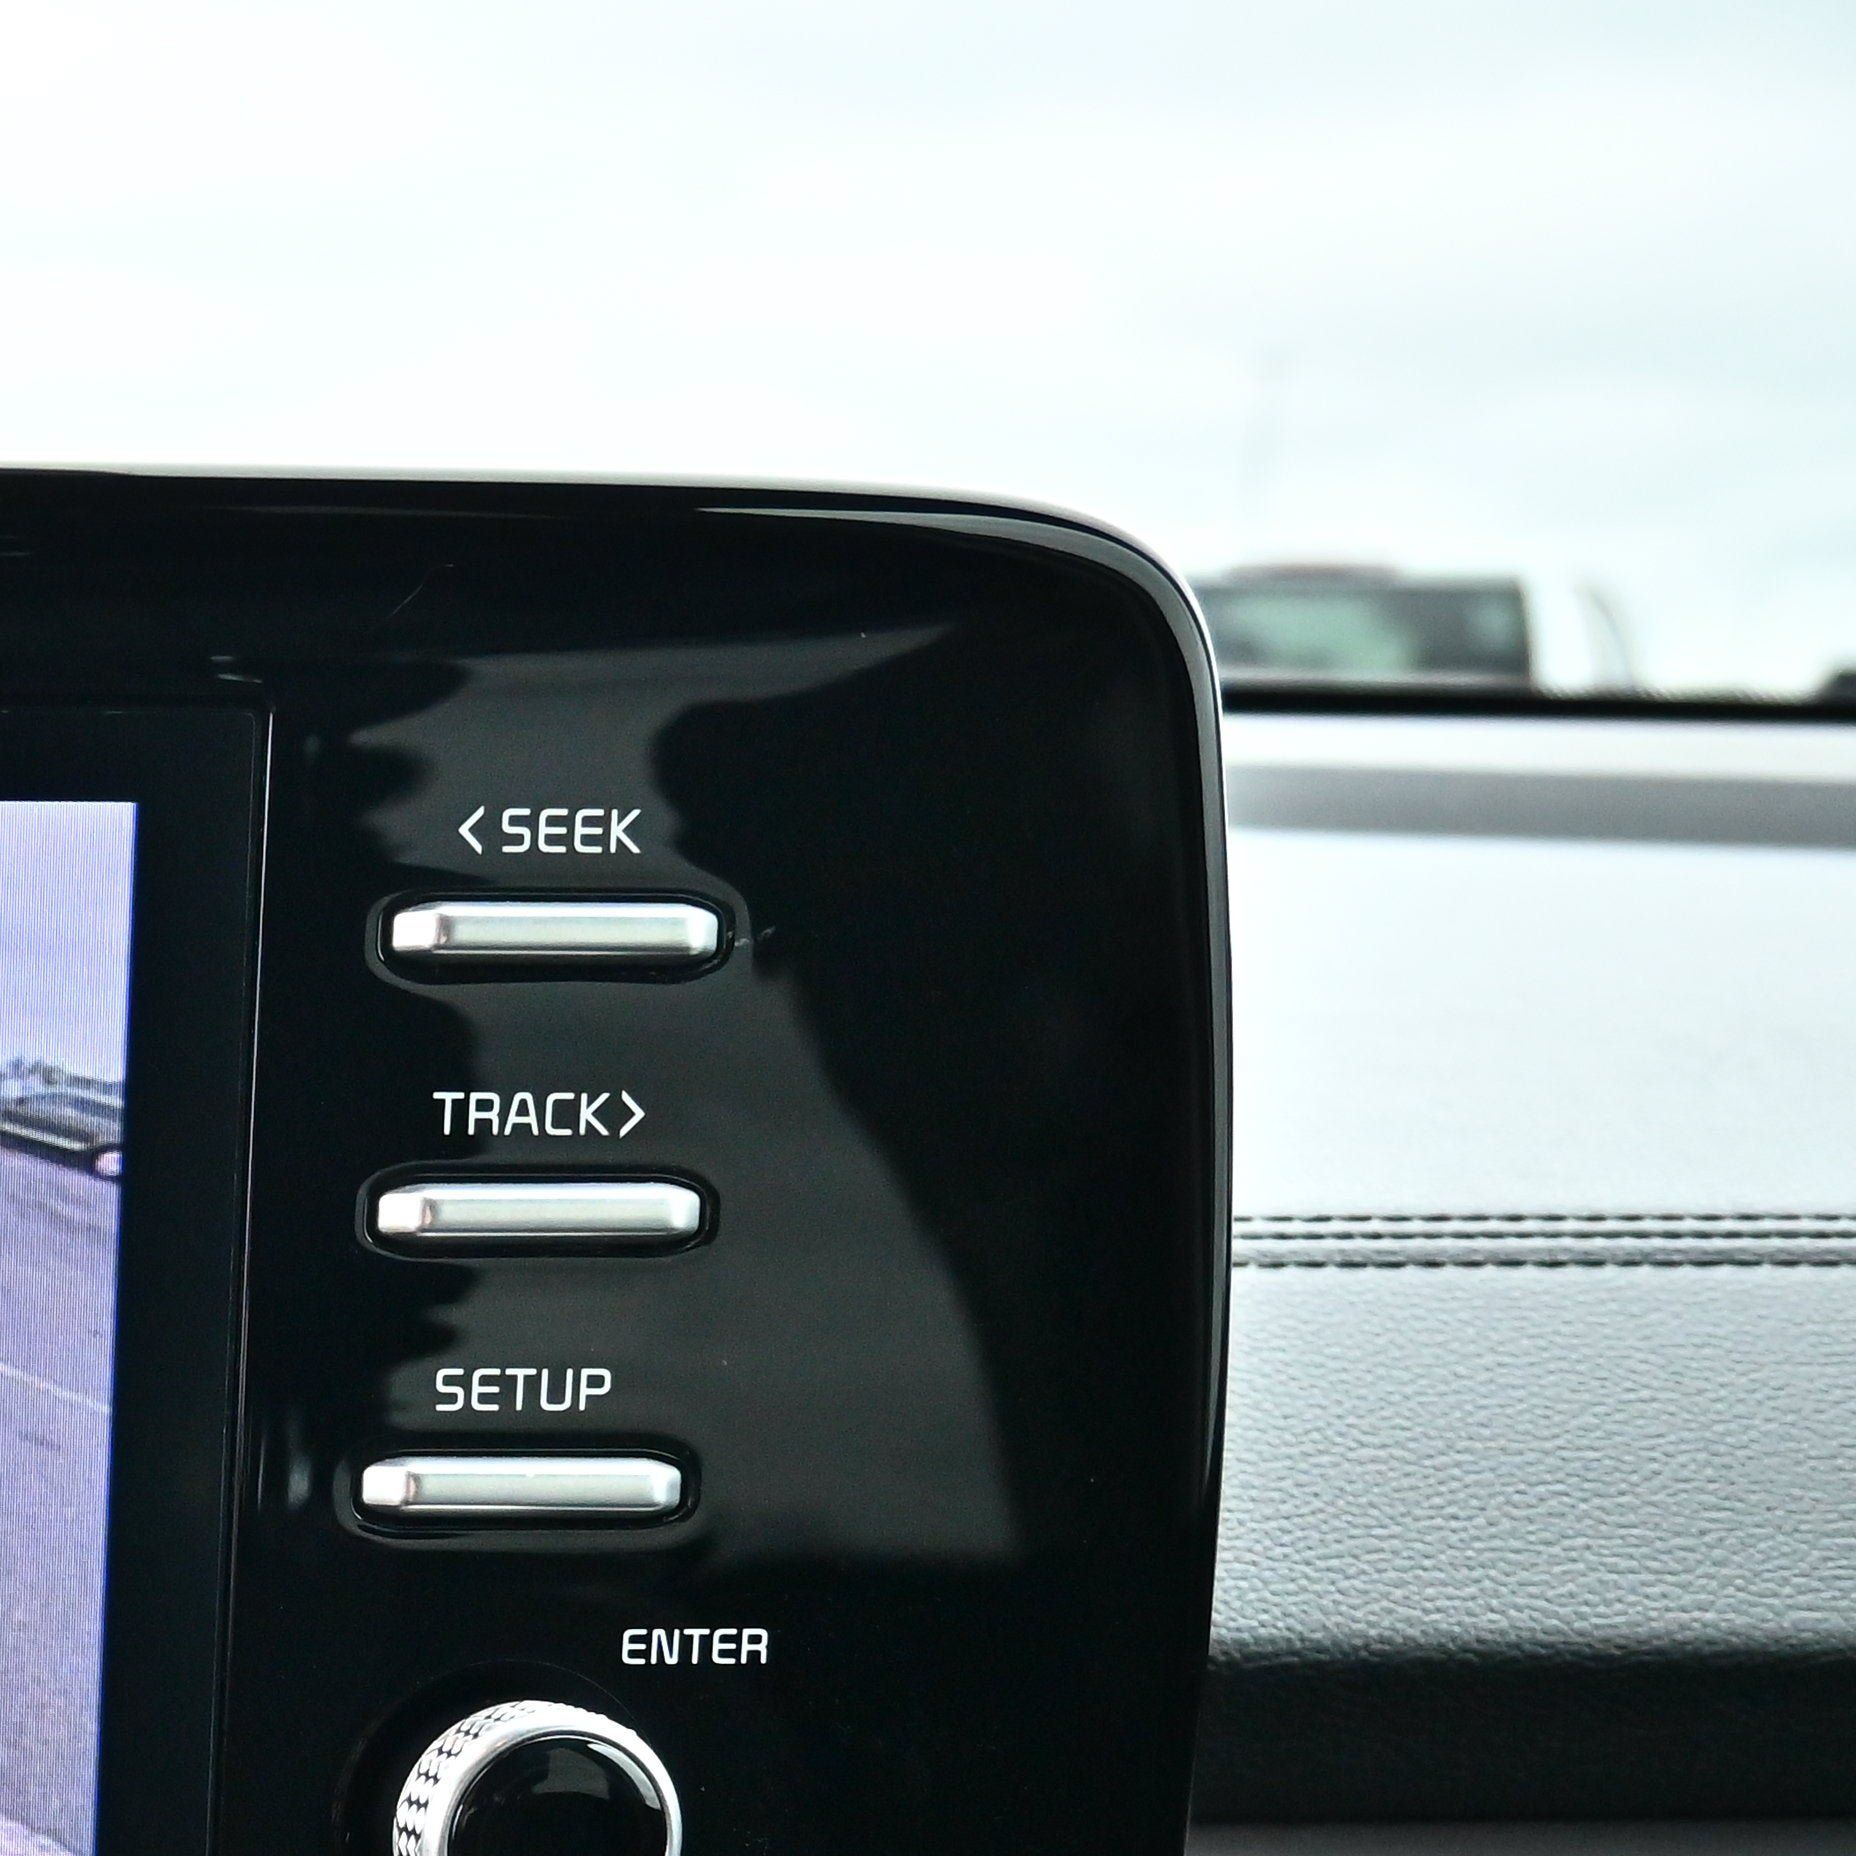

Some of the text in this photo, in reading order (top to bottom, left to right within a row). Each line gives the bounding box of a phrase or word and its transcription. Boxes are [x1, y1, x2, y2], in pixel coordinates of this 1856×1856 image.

[501, 807, 642, 854] SEEK
[435, 1367, 612, 1412] SETUP
[621, 1627, 768, 1665] ENTER
